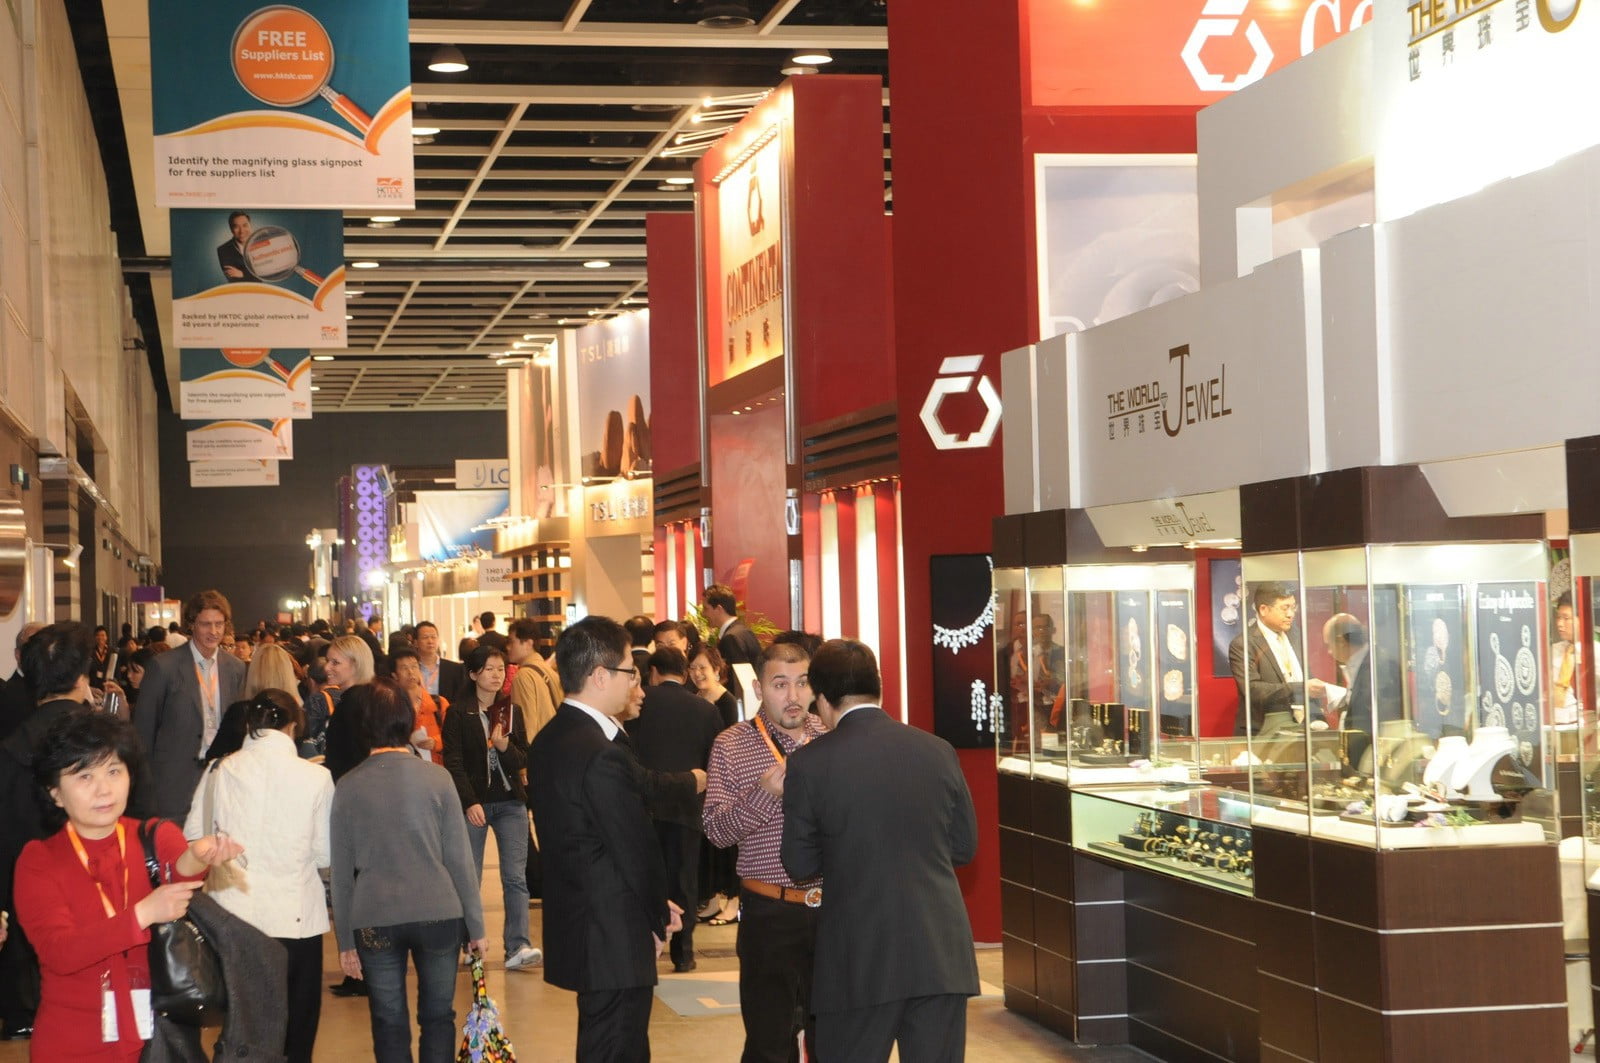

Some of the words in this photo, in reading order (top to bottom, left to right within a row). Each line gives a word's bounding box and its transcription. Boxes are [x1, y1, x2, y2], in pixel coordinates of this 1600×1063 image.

[258, 31, 307, 47] FREE
[241, 49, 299, 62] Suppliers
[302, 50, 325, 62] List
[168, 156, 209, 166] Identify
[212, 157, 229, 166] the
[231, 157, 288, 168] magnifying
[291, 158, 317, 168] glass
[320, 159, 362, 169] signpost
[168, 168, 183, 177] for
[186, 168, 207, 177] free
[210, 169, 257, 179] suppliers
[260, 169, 276, 178] list
[208, 313, 217, 321] by
[580, 343, 602, 364] TSL
[1108, 391, 1125, 414] THE
[1127, 381, 1160, 409] WORLD
[1162, 344, 1232, 438] JEWEL
[590, 502, 616, 521] TSL
